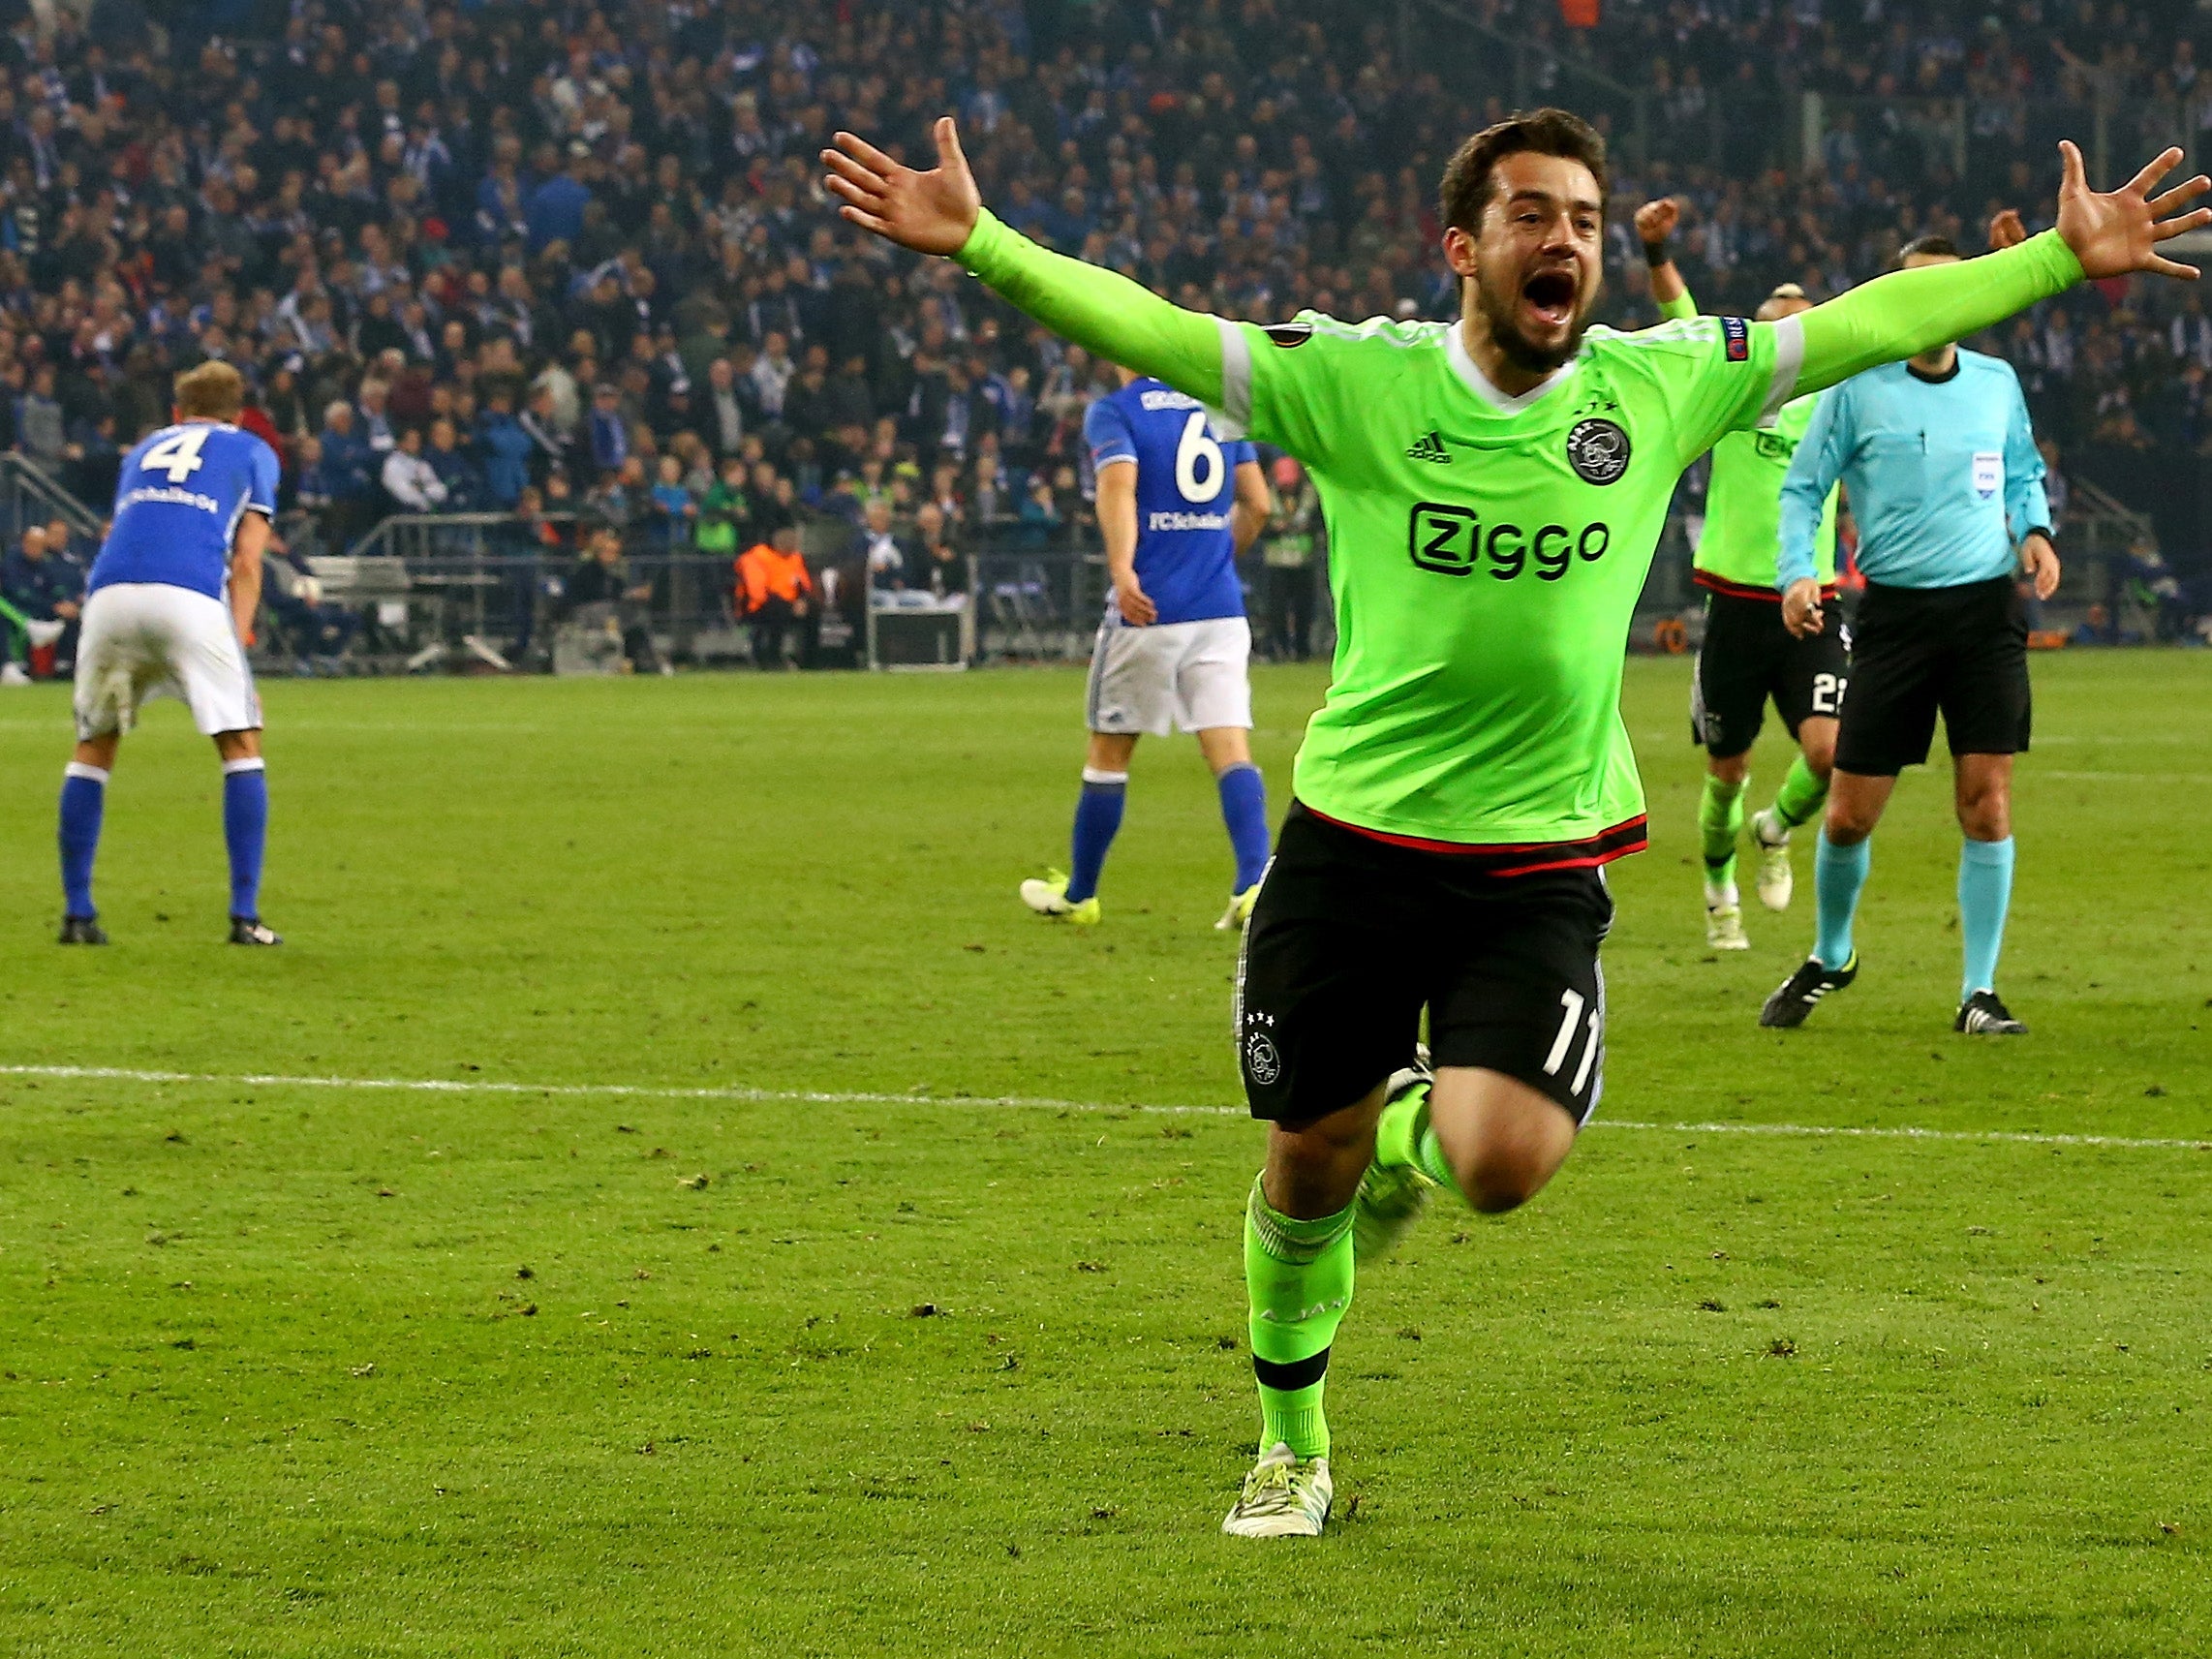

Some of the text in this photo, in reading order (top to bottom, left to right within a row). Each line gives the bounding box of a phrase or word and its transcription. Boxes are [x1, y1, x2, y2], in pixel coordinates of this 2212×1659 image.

[139, 427, 211, 483] 4
[1176, 411, 1224, 503] 6
[1406, 448, 1452, 464] adidas
[1410, 502, 1609, 581] Ziggo
[1542, 987, 1600, 1097] 11
